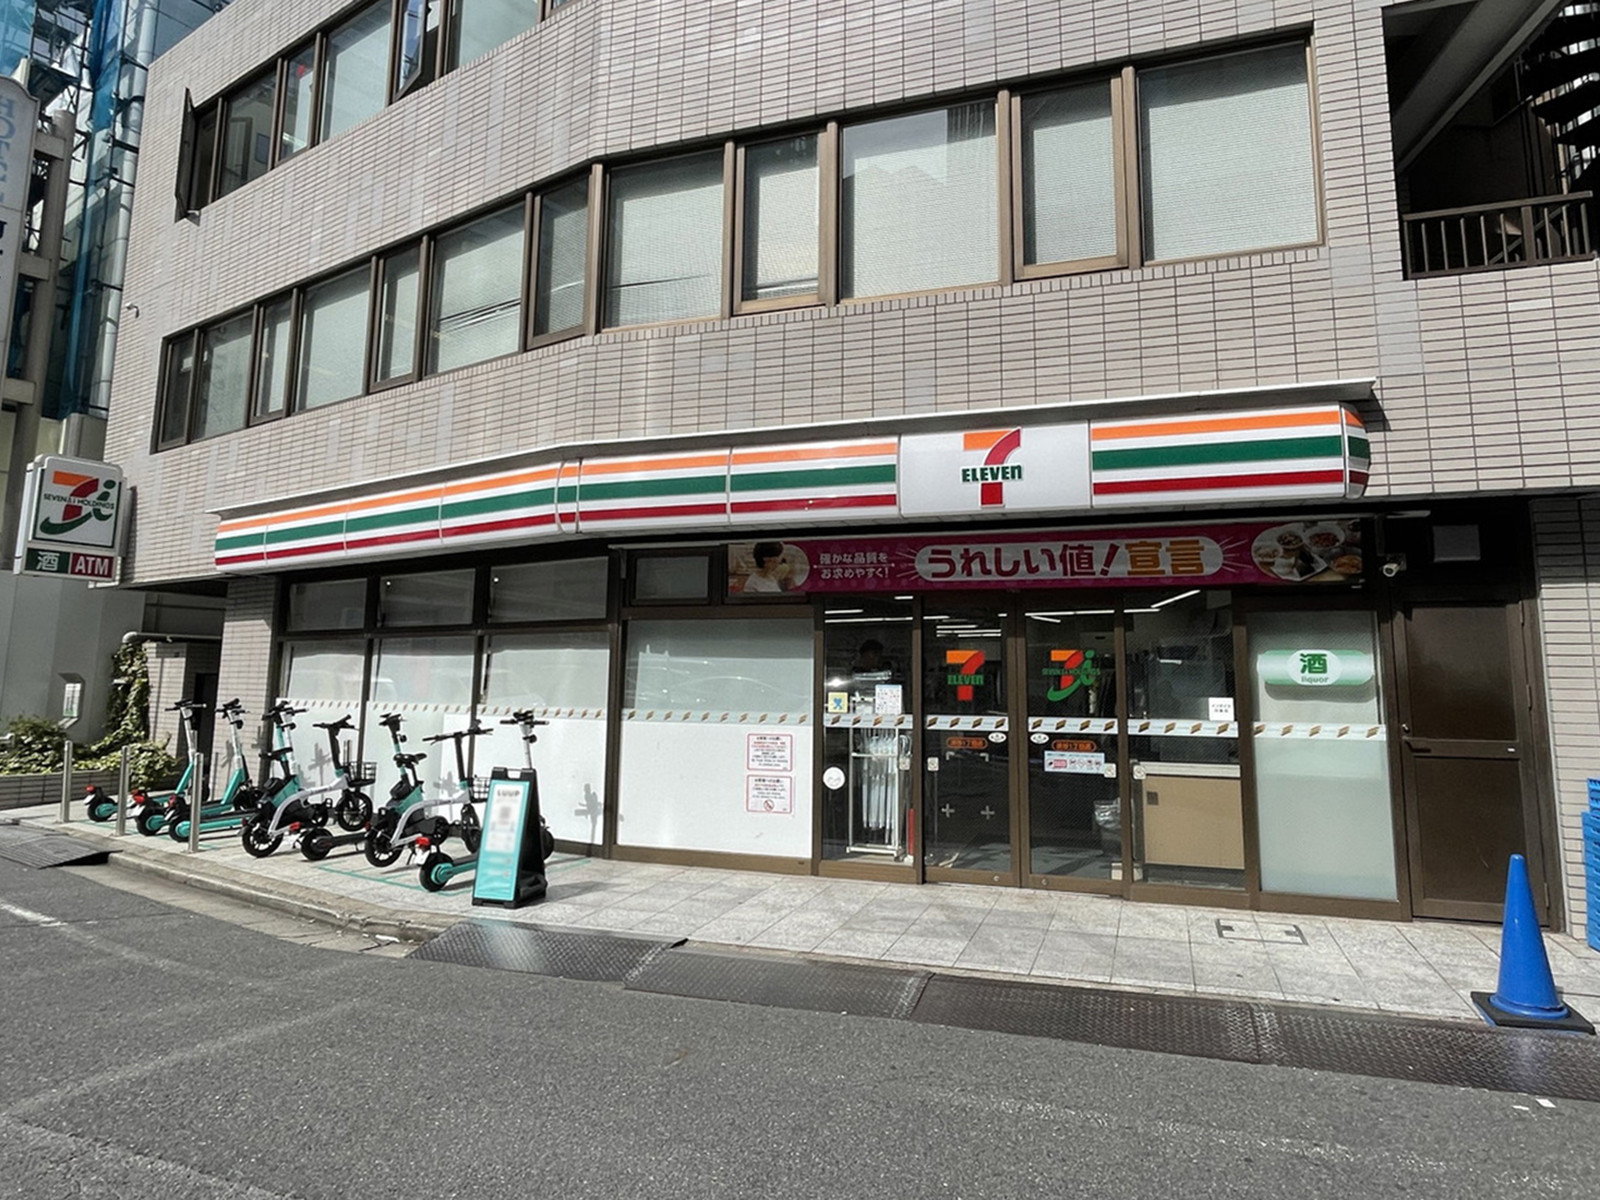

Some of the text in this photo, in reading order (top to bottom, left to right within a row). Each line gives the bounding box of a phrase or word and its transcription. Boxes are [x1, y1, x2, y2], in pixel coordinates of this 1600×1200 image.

[36, 551, 60, 571] 酒
[75, 555, 109, 576] ATM
[820, 551, 888, 565] 確かな品質を
[821, 567, 889, 579] お求めやすく!
[1299, 653, 1328, 674] 酒
[1301, 676, 1328, 684] liquor
